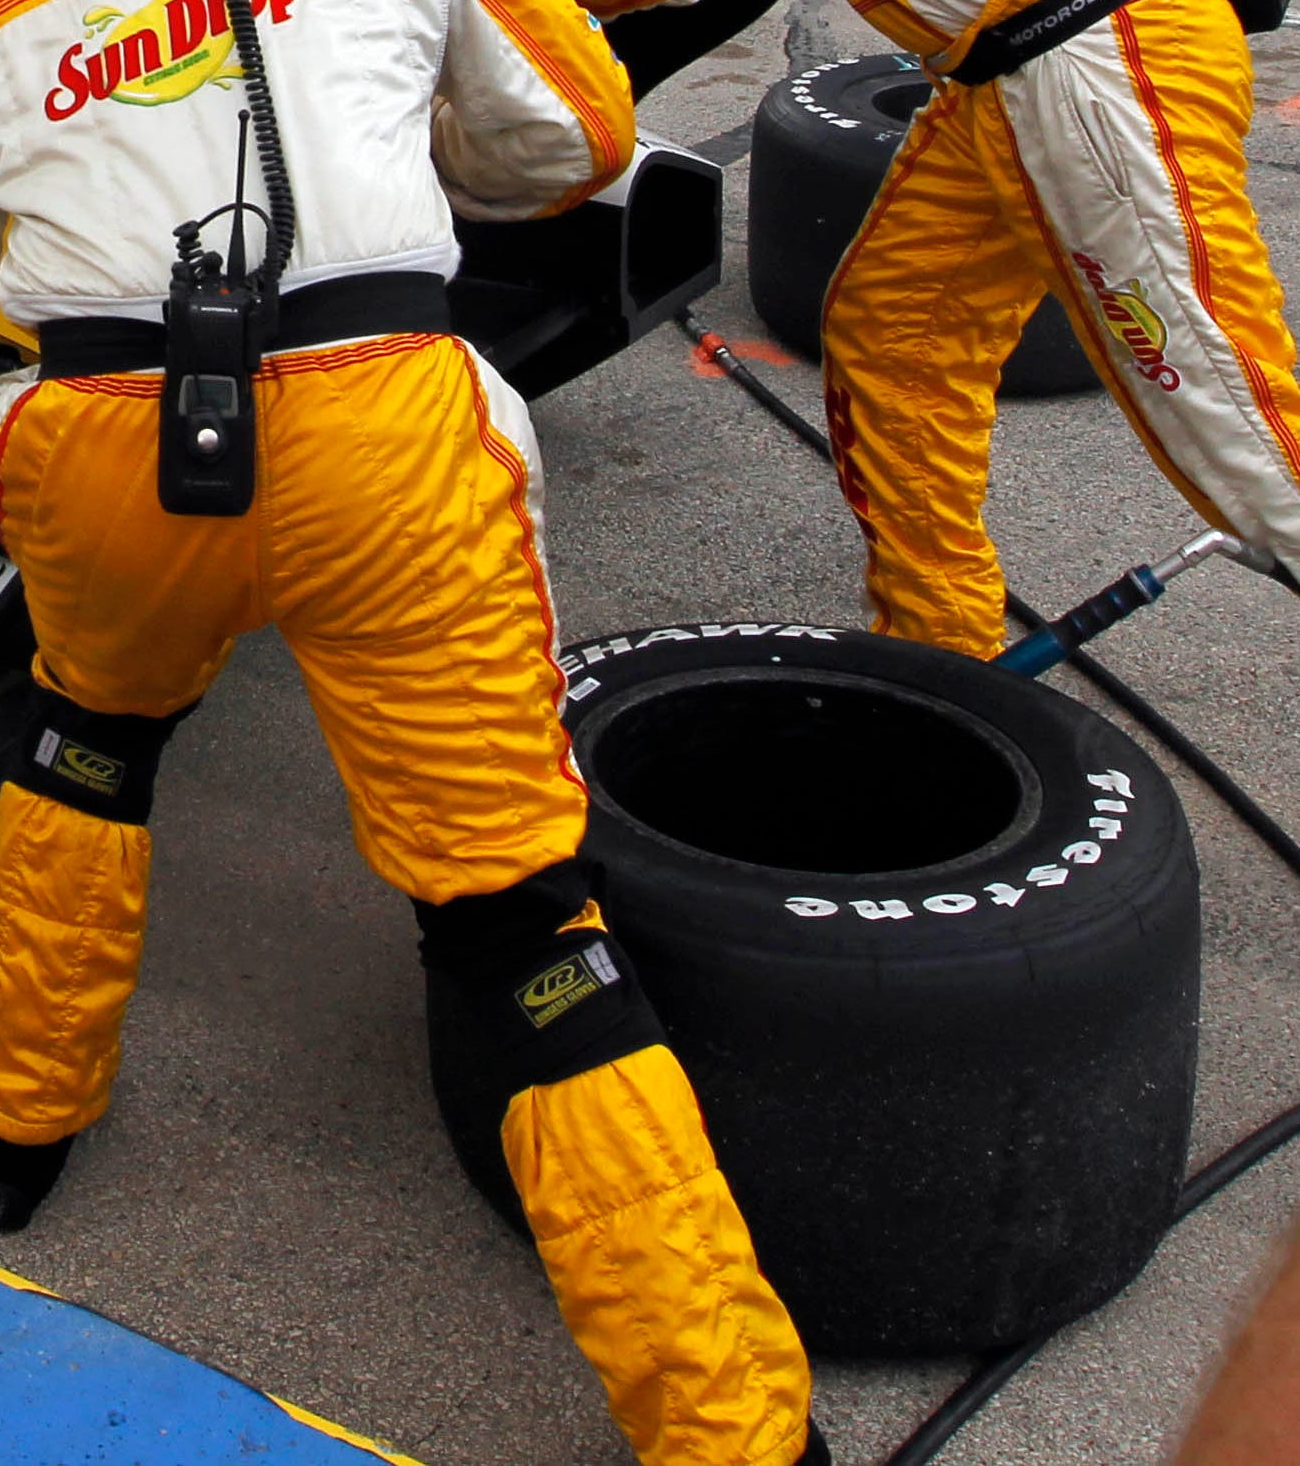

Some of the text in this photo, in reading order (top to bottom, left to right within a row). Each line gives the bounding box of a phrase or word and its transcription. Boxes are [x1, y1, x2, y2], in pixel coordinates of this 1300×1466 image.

[44, 28, 162, 122] Sun
[1071, 251, 1181, 392] Sun Drop
[557, 623, 848, 676] EHAWK
[784, 768, 1136, 921] Firestone
